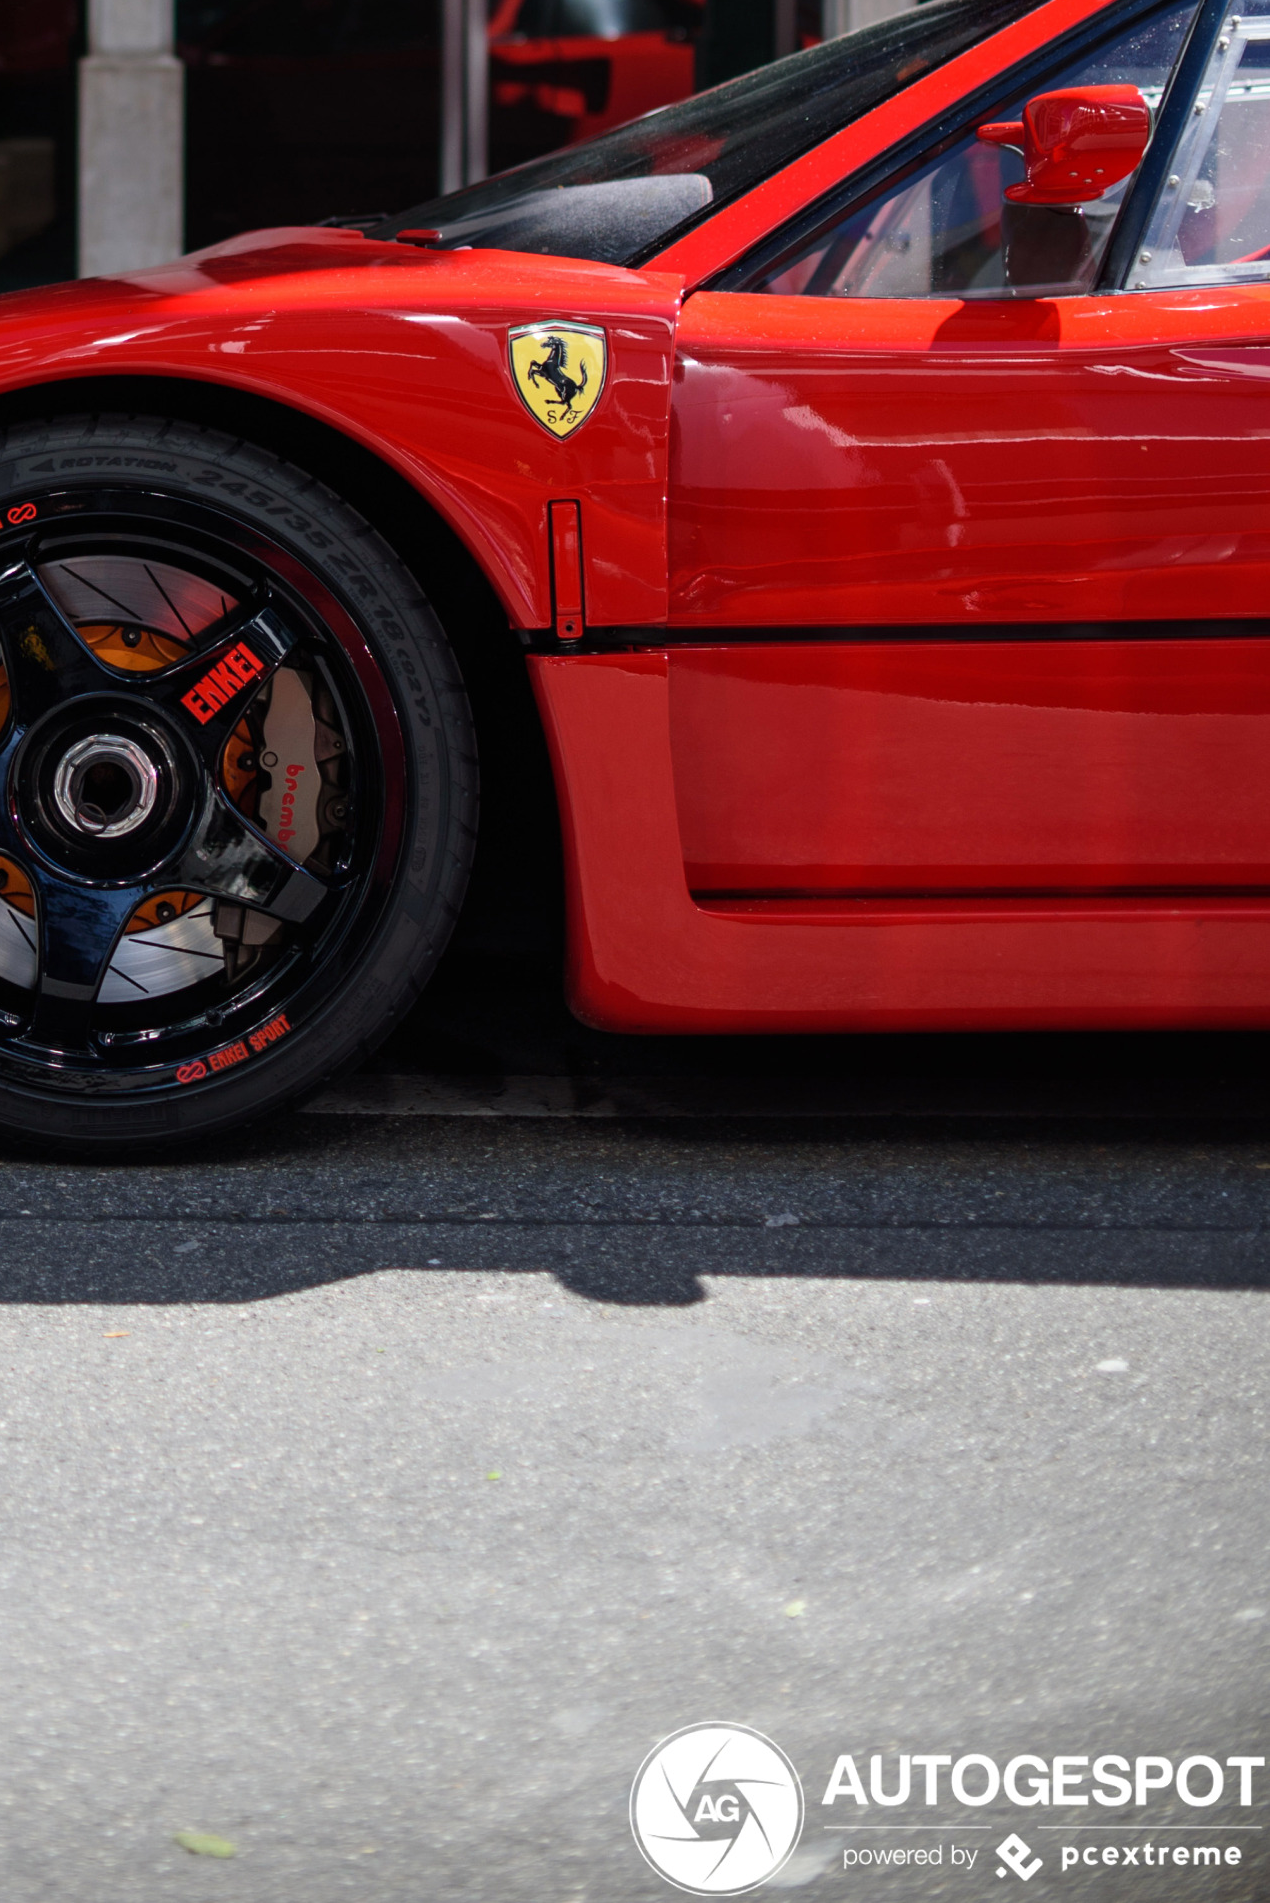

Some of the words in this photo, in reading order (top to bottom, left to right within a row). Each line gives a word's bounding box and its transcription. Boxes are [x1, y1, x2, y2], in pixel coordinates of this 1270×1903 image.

[547, 410, 557, 424] S
[567, 410, 583, 424] F
[58, 456, 178, 473] ROTATION
[192, 469, 334, 550] 245/35
[373, 602, 406, 643] 18
[180, 641, 265, 725] ENKEI
[209, 1041, 250, 1072] ENKEI
[249, 1014, 291, 1052] SPORT
